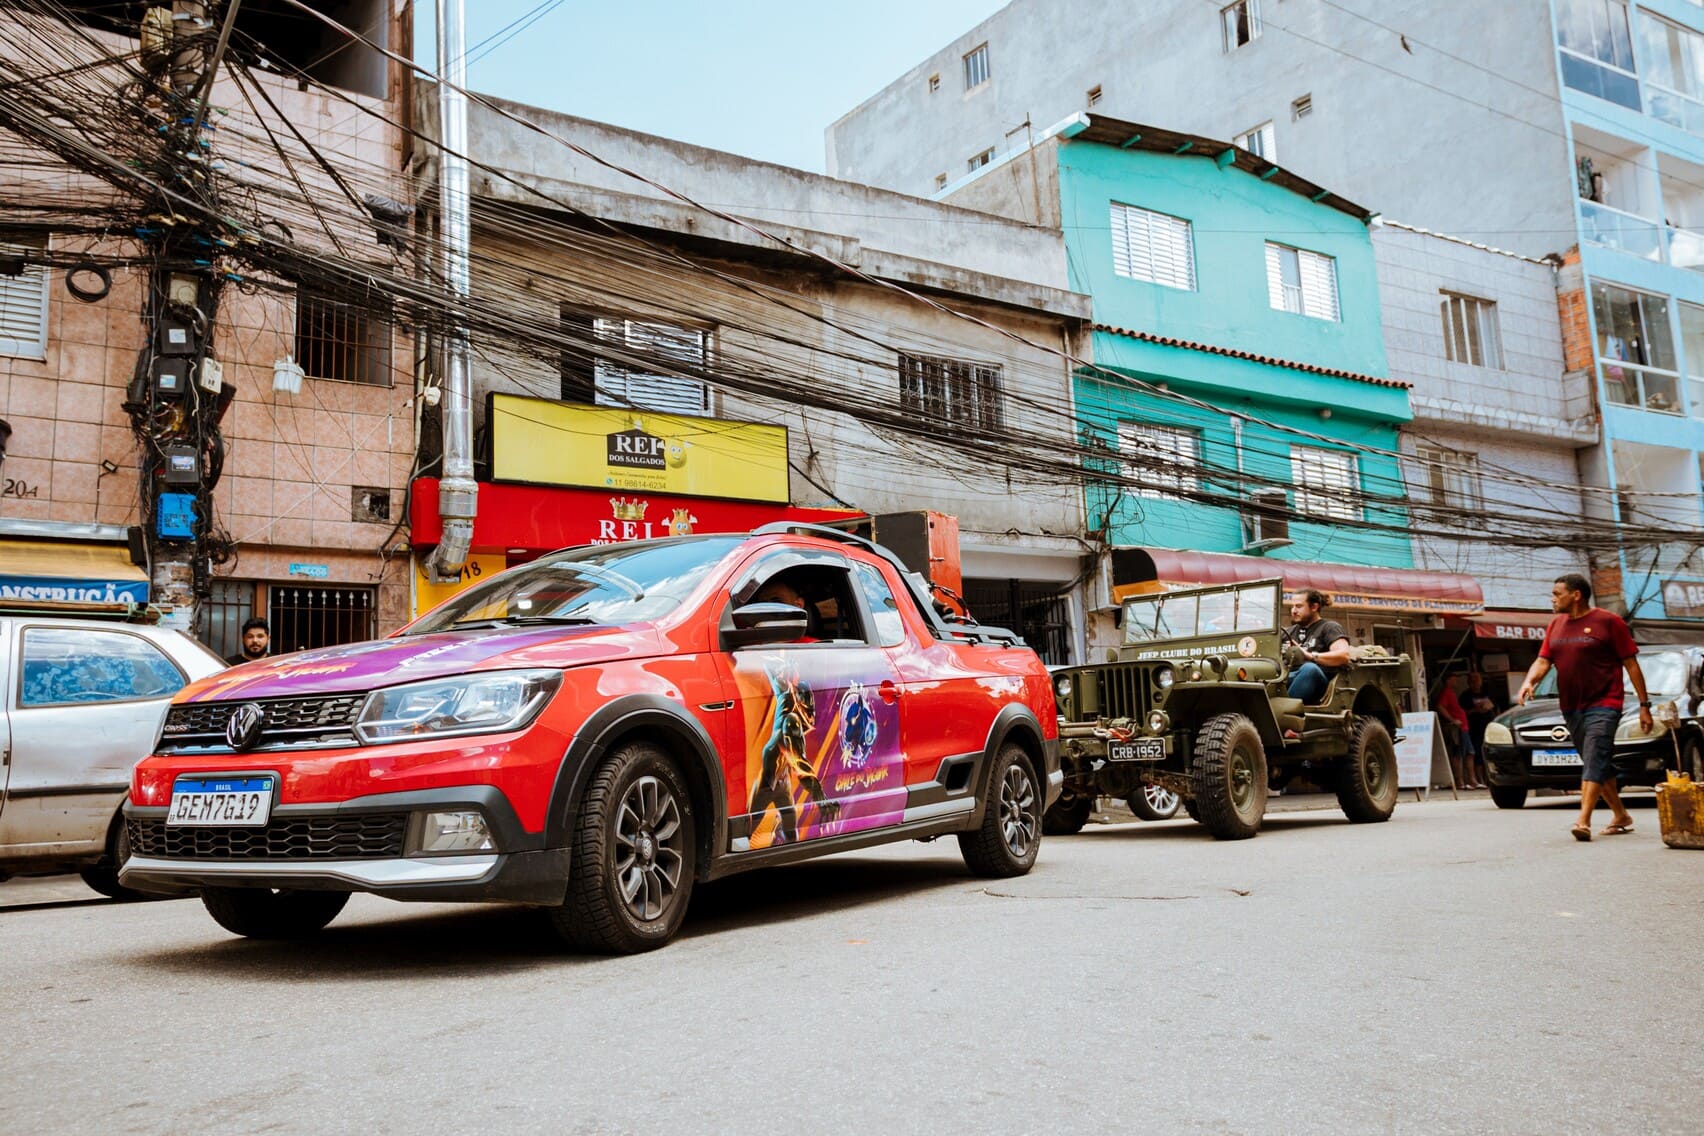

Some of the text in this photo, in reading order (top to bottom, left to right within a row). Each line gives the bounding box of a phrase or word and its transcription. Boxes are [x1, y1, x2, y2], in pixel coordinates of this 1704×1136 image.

[615, 434, 659, 455] REI
[609, 453, 666, 466] DOS SALGADOS
[598, 519, 653, 541] REI
[1333, 595, 1363, 604] XEROX
[1369, 597, 1409, 608] SERVIÇOS
[1412, 600, 1423, 608] DE
[1496, 625, 1546, 640] BAR DO
[1137, 644, 1238, 660] JEEP CLUBE DO BRASIL
[177, 793, 260, 820] GEM7G19
